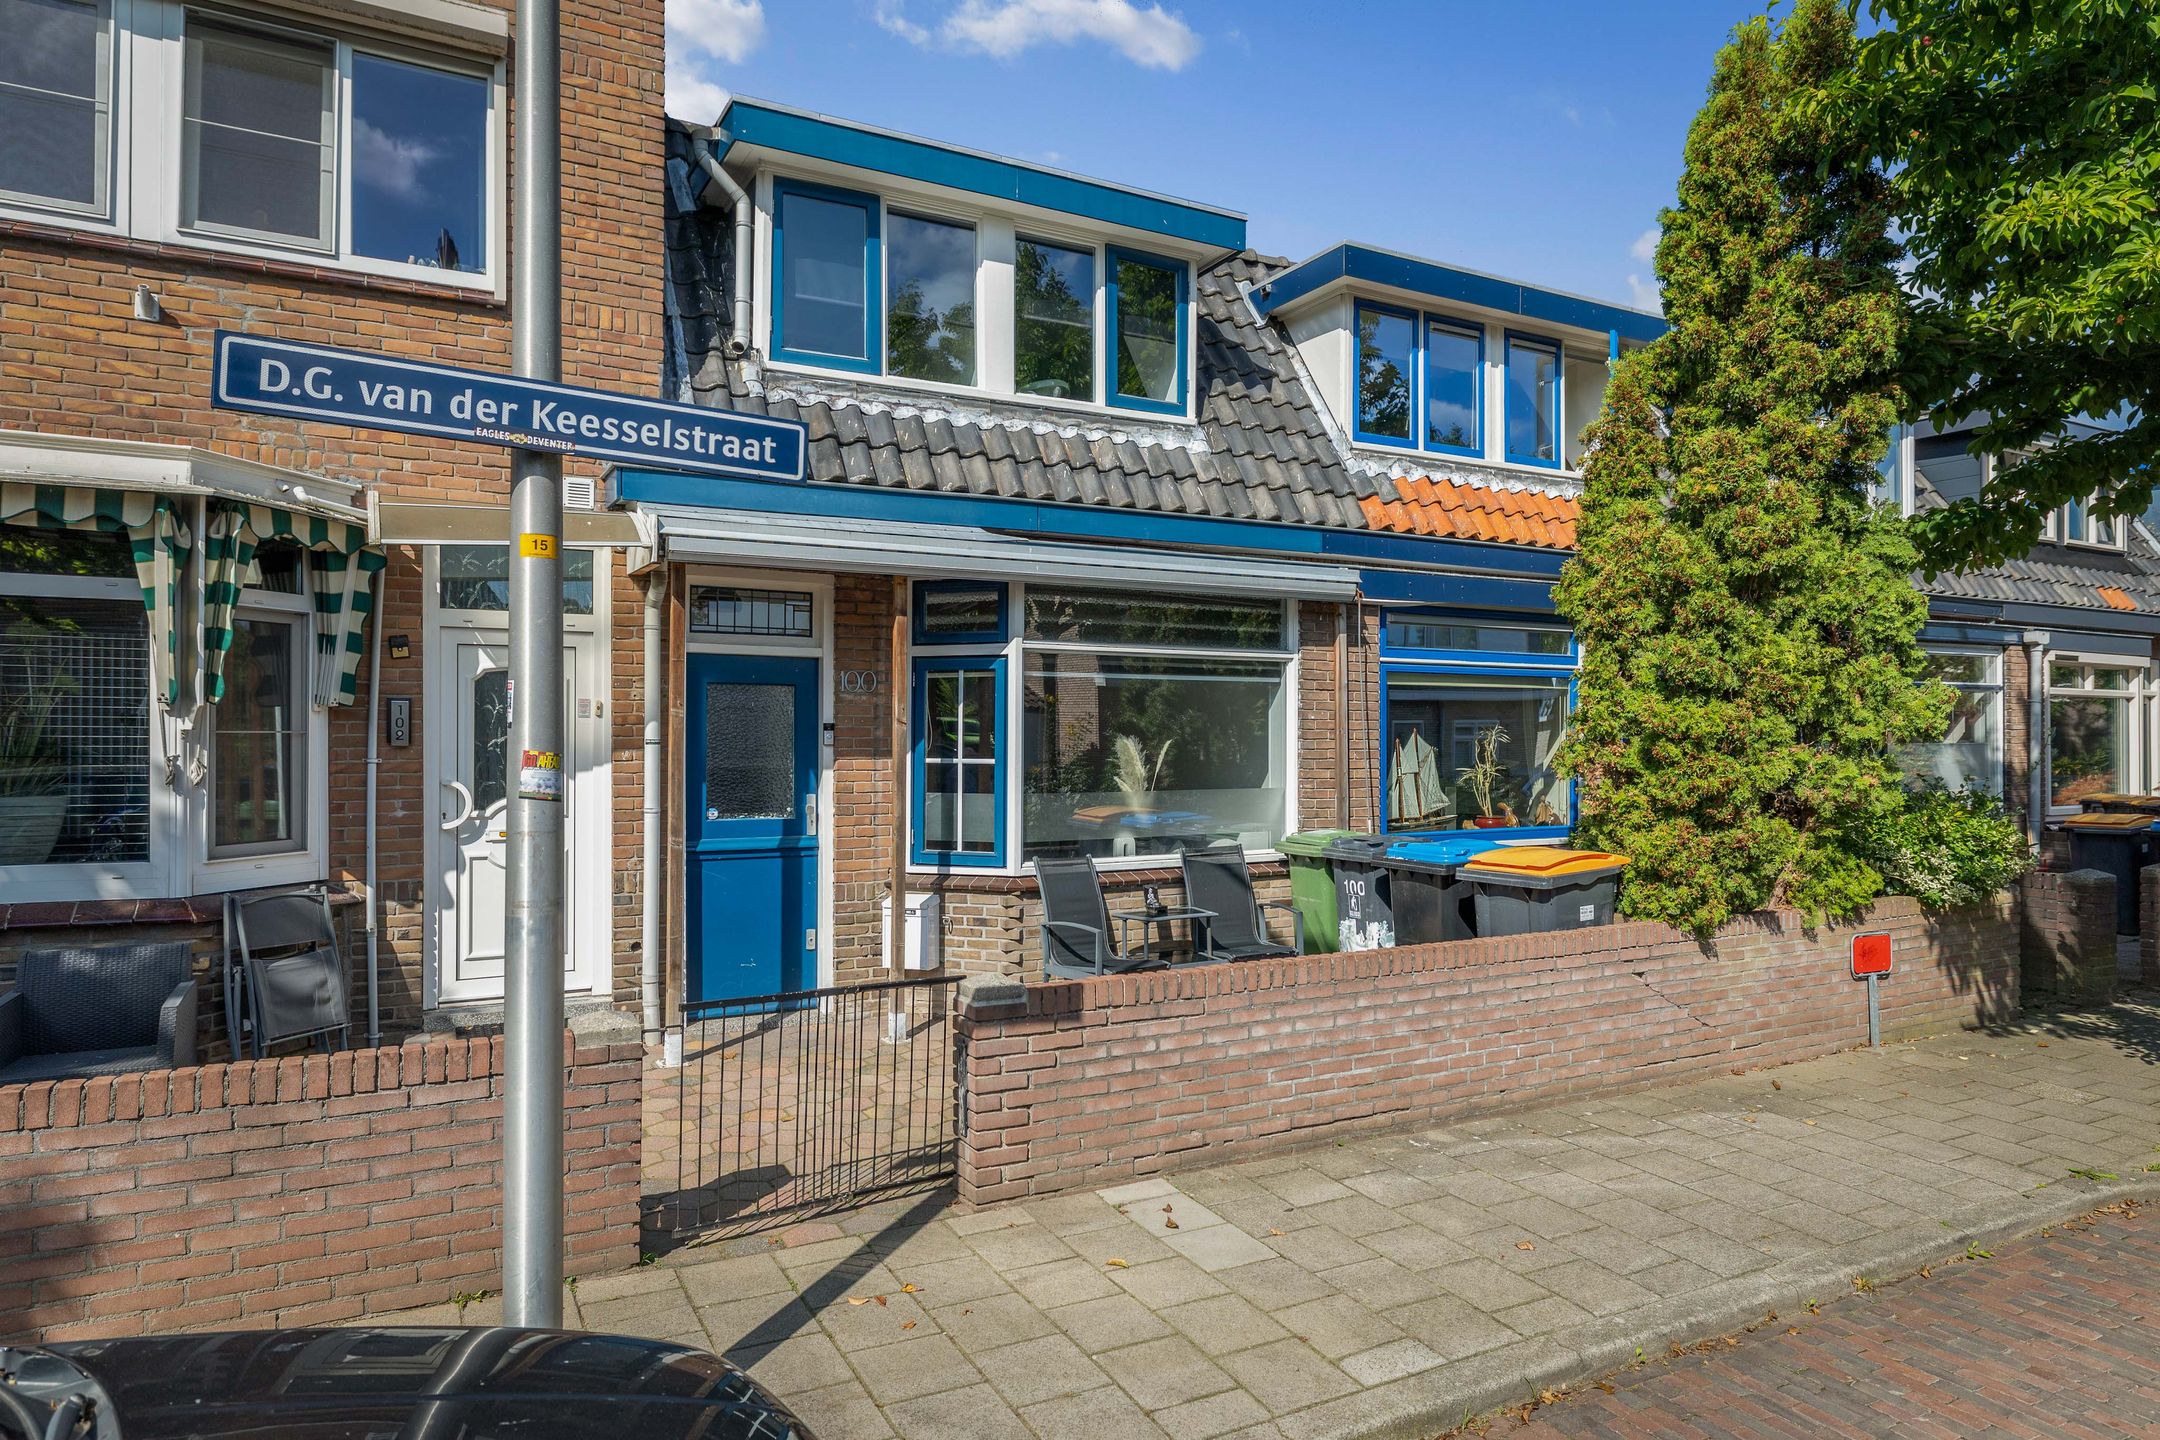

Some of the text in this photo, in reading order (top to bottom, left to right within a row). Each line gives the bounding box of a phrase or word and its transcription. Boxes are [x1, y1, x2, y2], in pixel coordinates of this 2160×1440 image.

[259, 358, 777, 464] D.G. van der Keesselstraat
[476, 427, 573, 451] EAGLES DEVENTER
[532, 539, 548, 551] 15
[839, 670, 877, 693] 100
[395, 704, 405, 741] 102
[1343, 879, 1365, 896] 100
